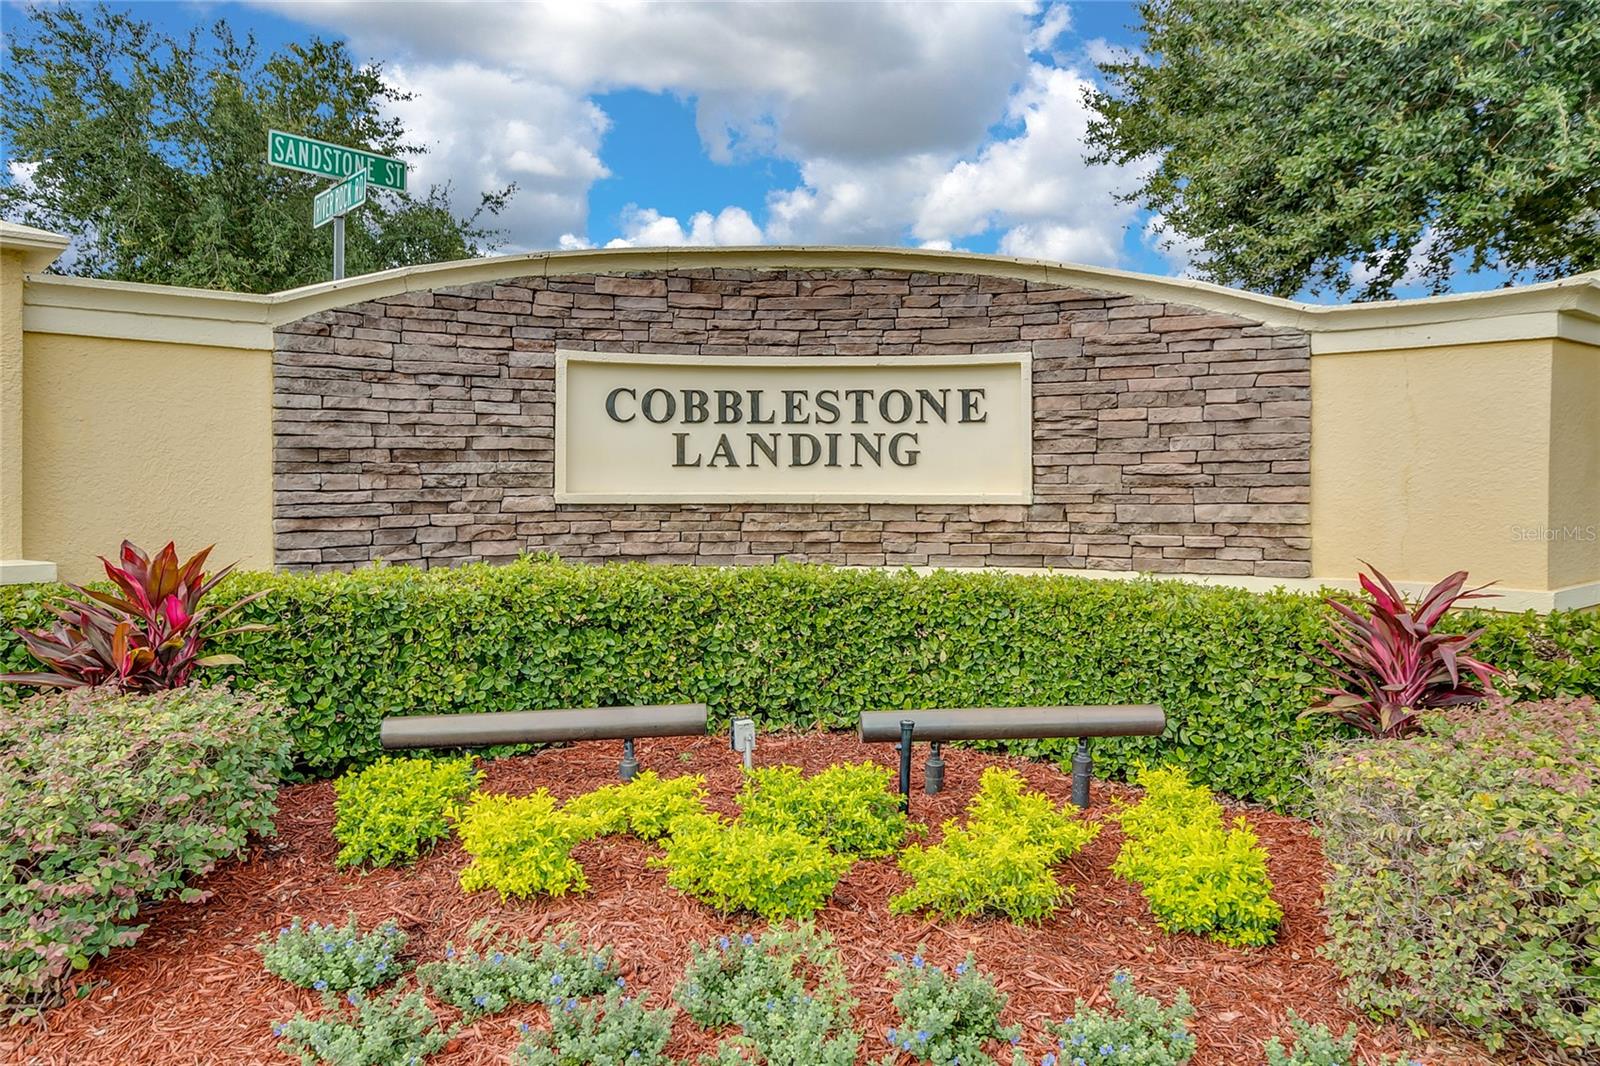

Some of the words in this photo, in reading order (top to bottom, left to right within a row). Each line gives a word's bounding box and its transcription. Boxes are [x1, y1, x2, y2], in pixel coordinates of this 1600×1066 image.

[274, 136, 375, 182] SANDSTONE
[385, 162, 403, 187] ST
[354, 175, 364, 203] RD
[605, 387, 989, 424] COBBLESTONE
[671, 432, 921, 468] LANDING
